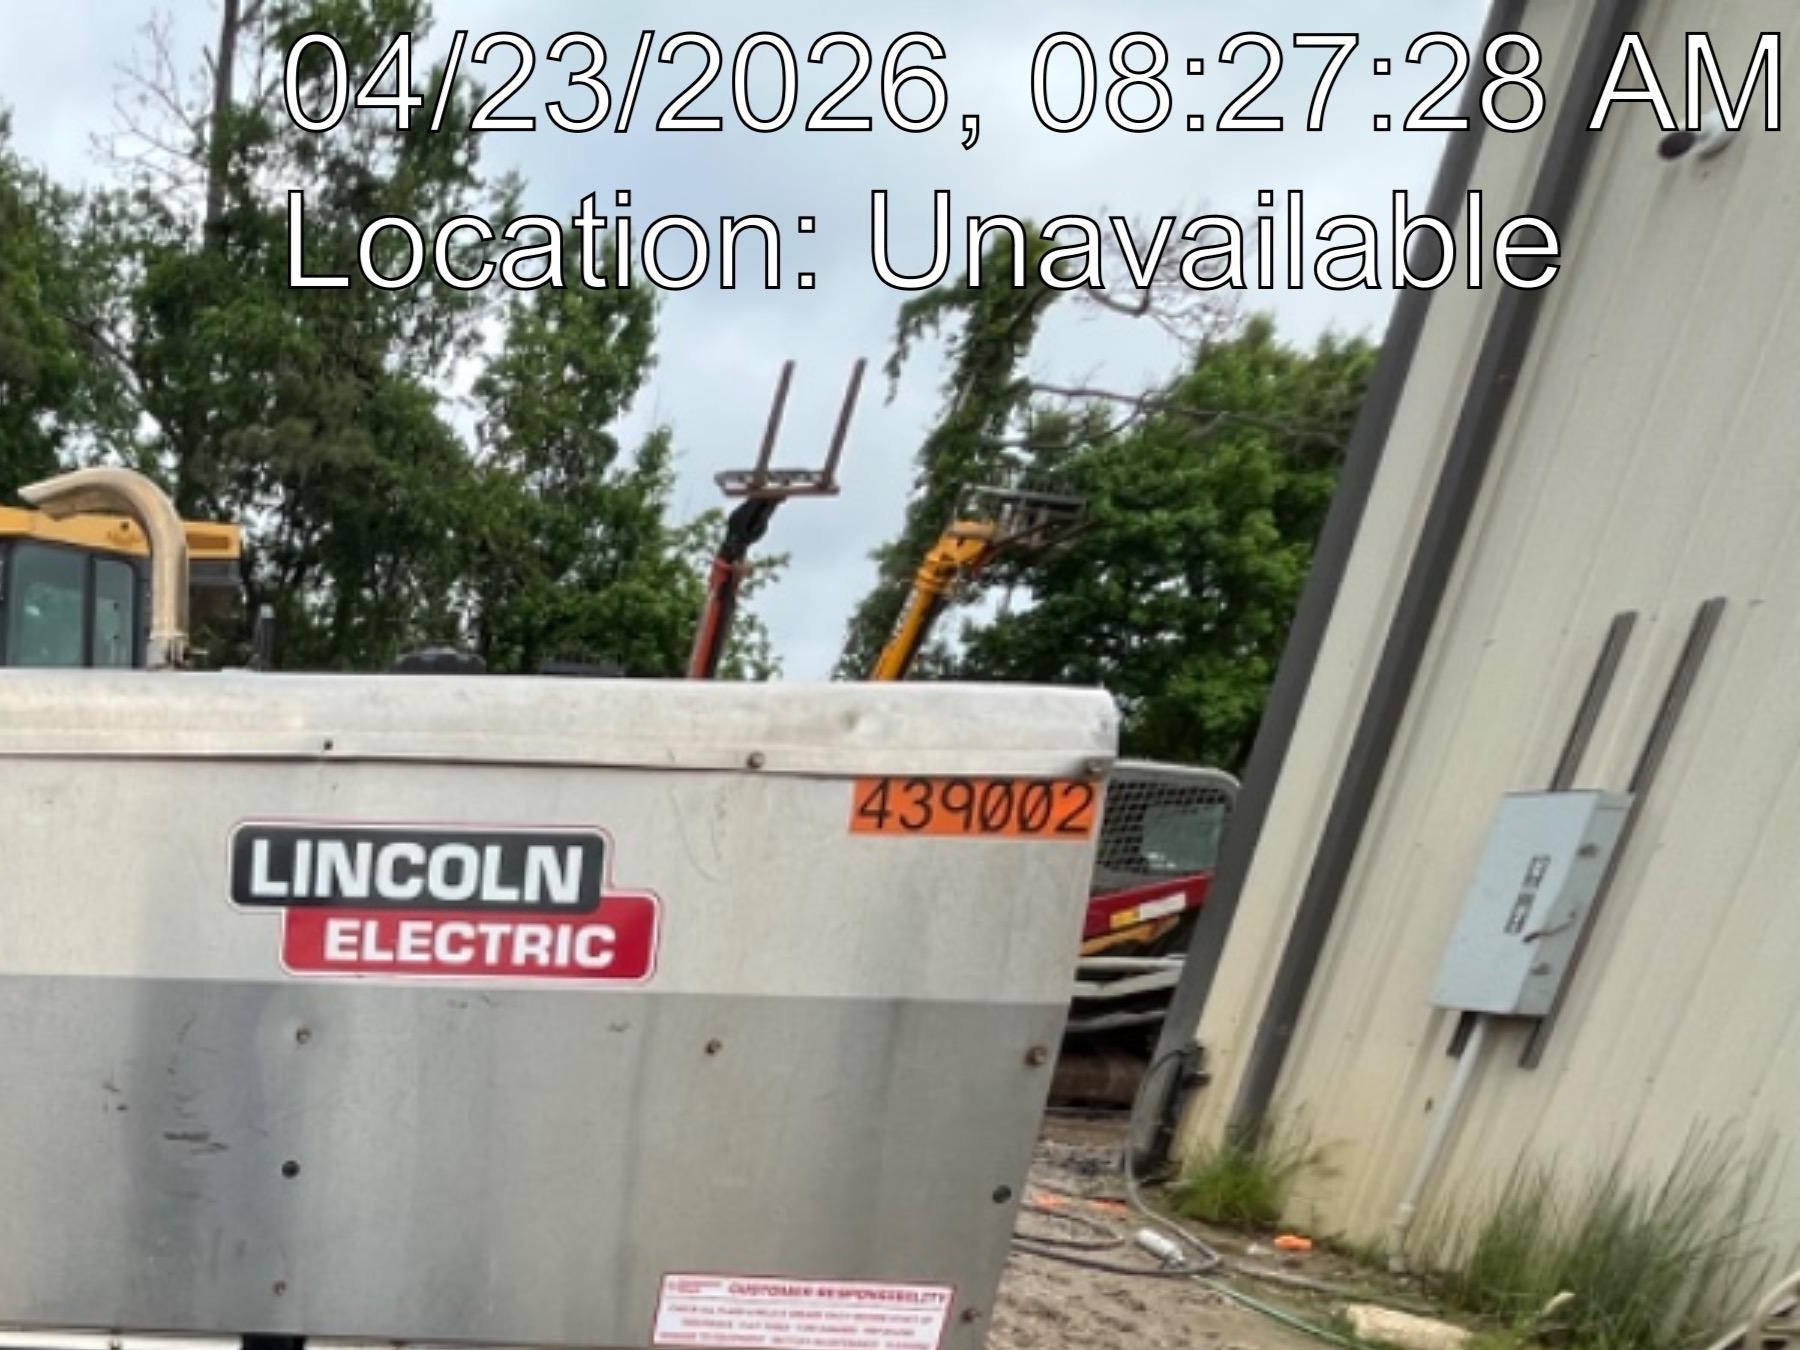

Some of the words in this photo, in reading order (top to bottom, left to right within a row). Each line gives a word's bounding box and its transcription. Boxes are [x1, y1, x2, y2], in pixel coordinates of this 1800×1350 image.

[856, 777, 1094, 833] 439002
[250, 839, 583, 904] LINCOLN
[324, 918, 616, 968] ELECTRIC
